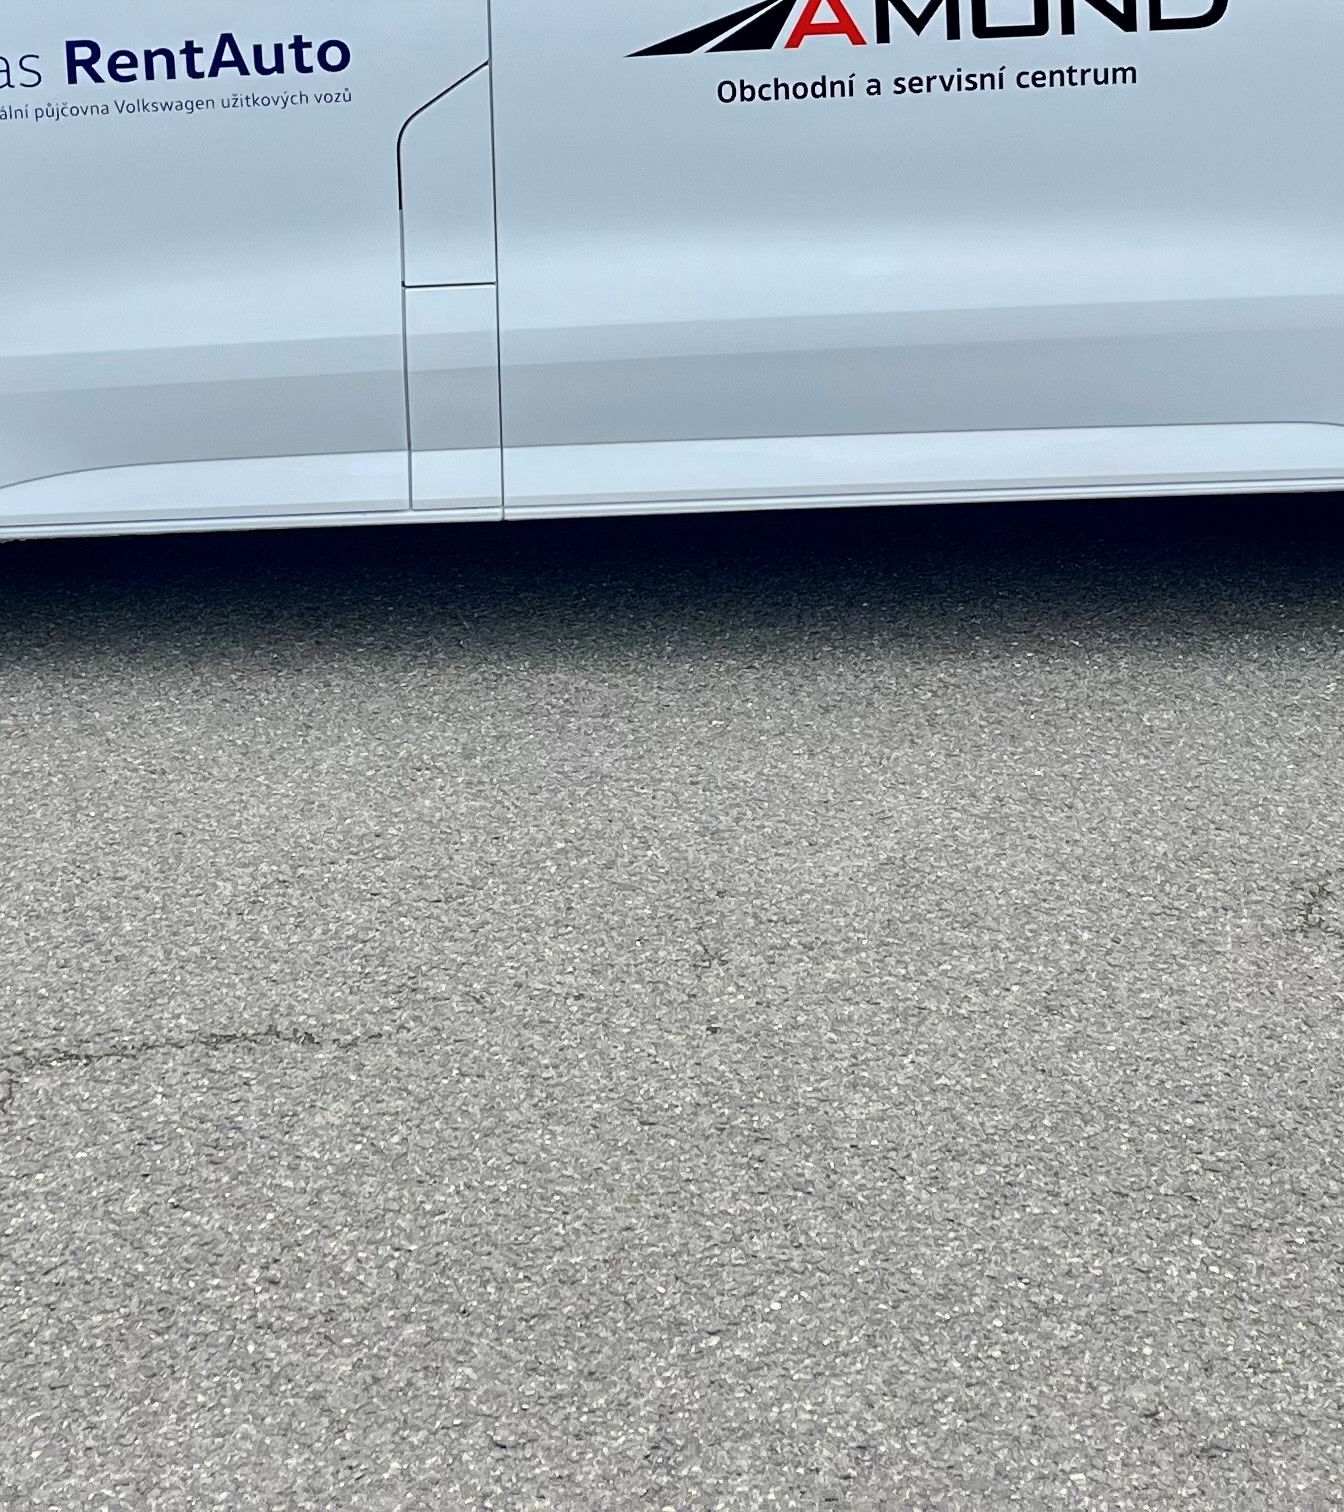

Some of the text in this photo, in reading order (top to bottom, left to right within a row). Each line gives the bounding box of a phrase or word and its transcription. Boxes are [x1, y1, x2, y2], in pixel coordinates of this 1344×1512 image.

[64, 32, 351, 86] RentAuto
[716, 64, 1138, 104] Obchodní a servisní centrum
[34, 101, 110, 123] půjčovna
[113, 98, 216, 115] Volkswagen
[221, 90, 309, 110] užitkových
[313, 87, 353, 104] vozů
